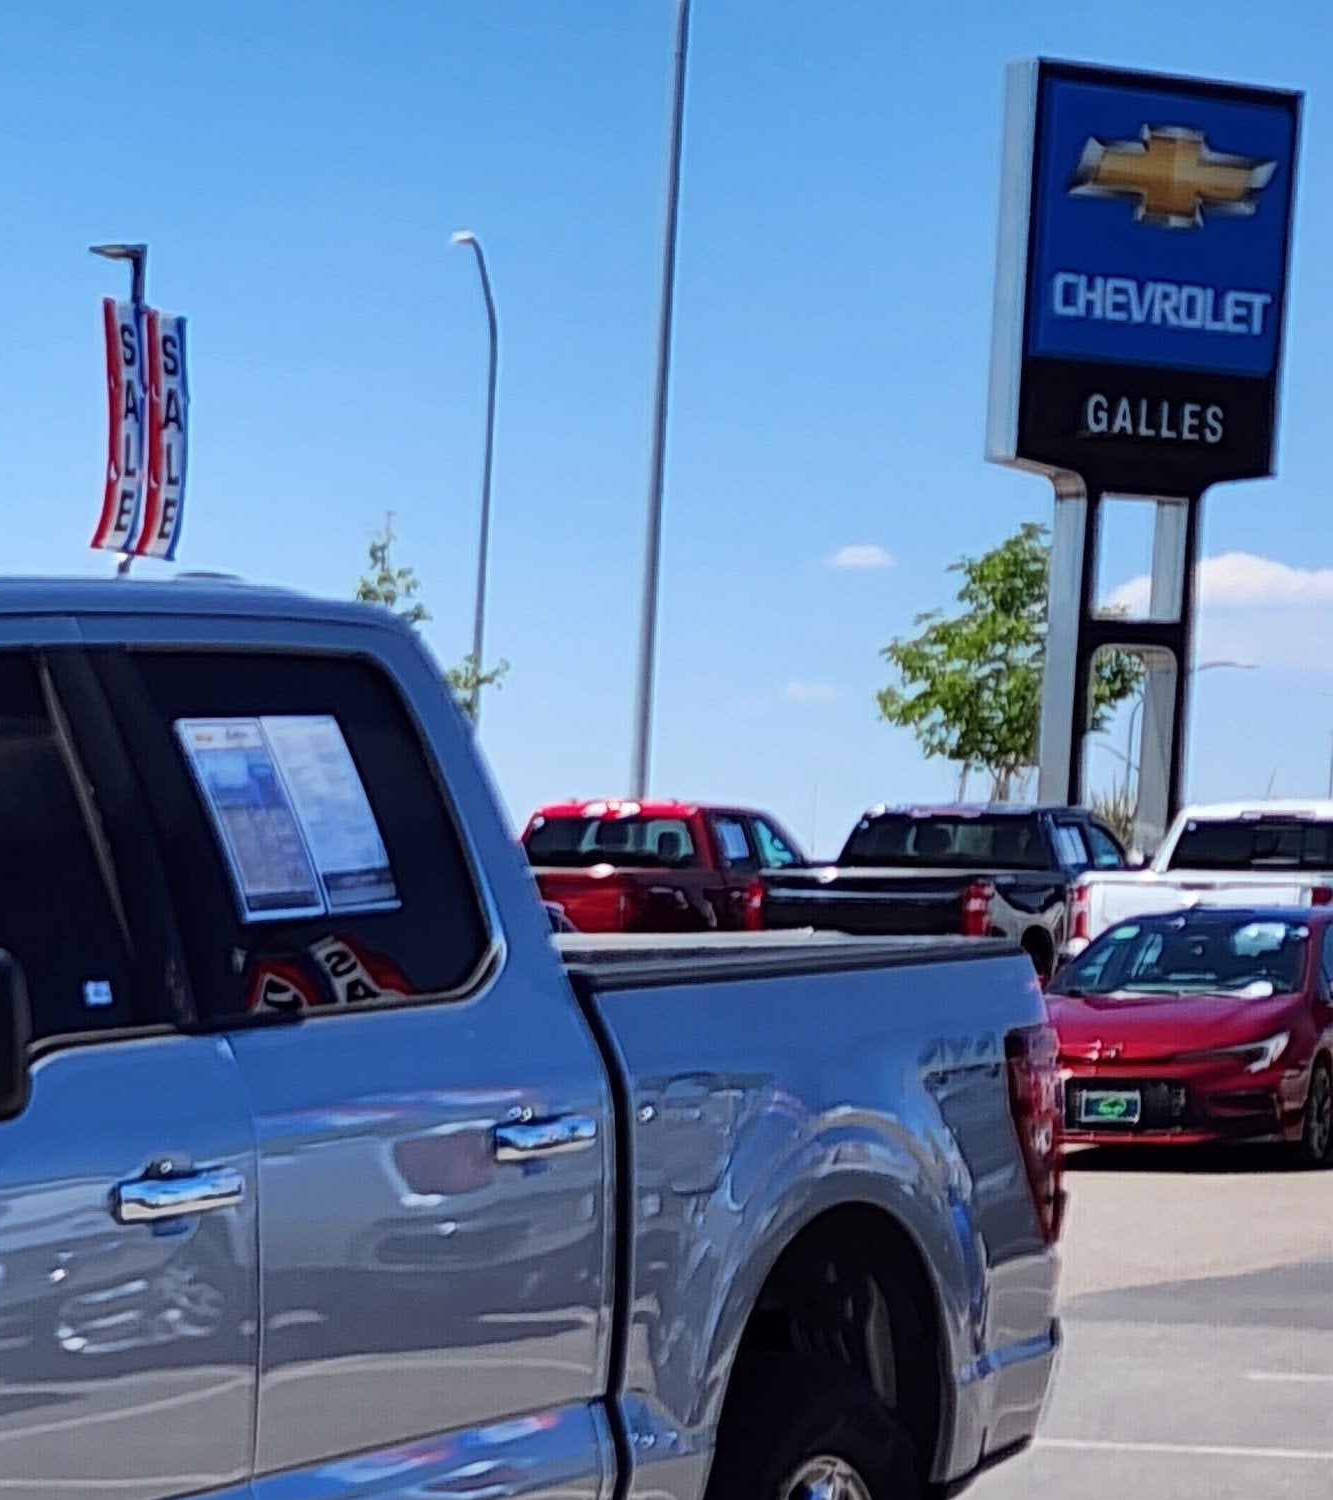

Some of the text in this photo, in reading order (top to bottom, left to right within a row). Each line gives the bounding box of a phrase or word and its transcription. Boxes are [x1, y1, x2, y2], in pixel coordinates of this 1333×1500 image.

[1050, 271, 1272, 336] CHEVROLET
[114, 322, 140, 533] SALE
[158, 334, 184, 540] SALE
[1086, 393, 1225, 444] GALLES
